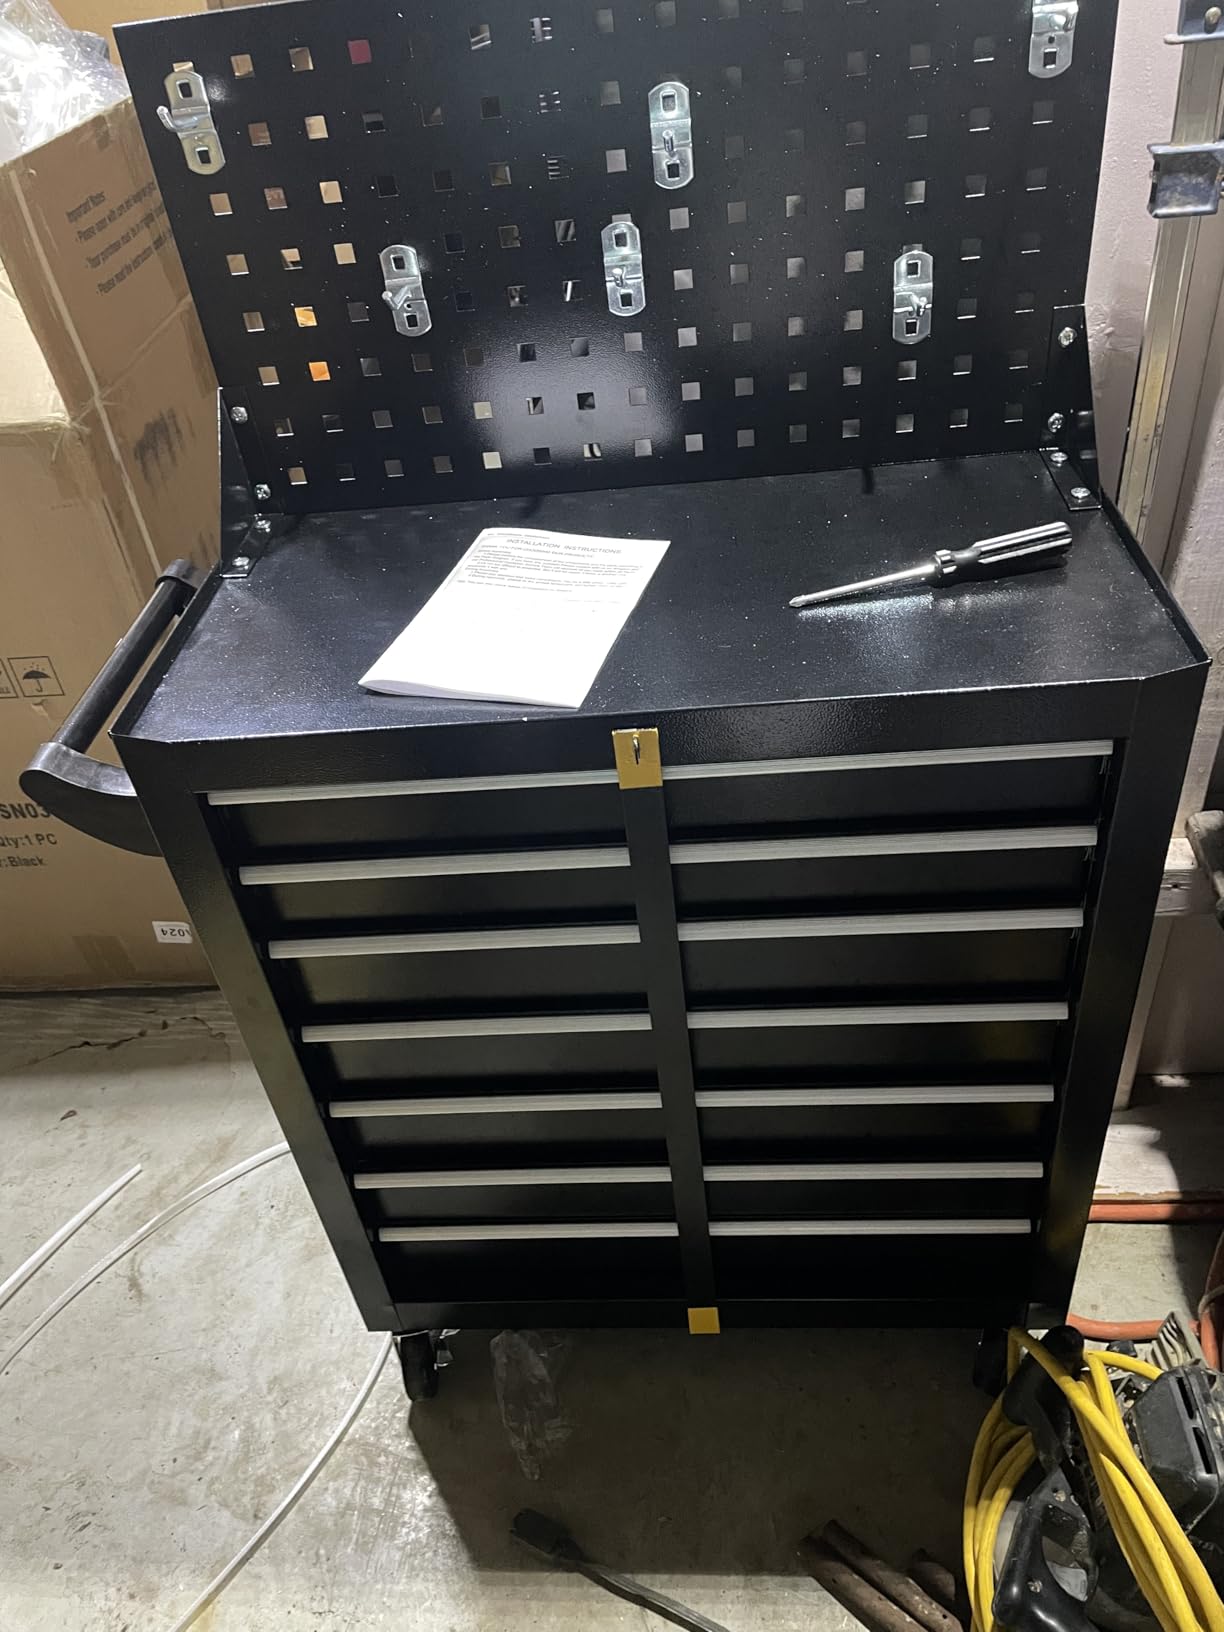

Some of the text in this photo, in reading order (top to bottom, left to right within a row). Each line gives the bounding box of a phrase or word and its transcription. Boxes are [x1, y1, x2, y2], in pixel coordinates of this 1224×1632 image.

[506, 538, 622, 554] INSTALLATION INSTRUCTIONS
[35, 833, 58, 846] PC
